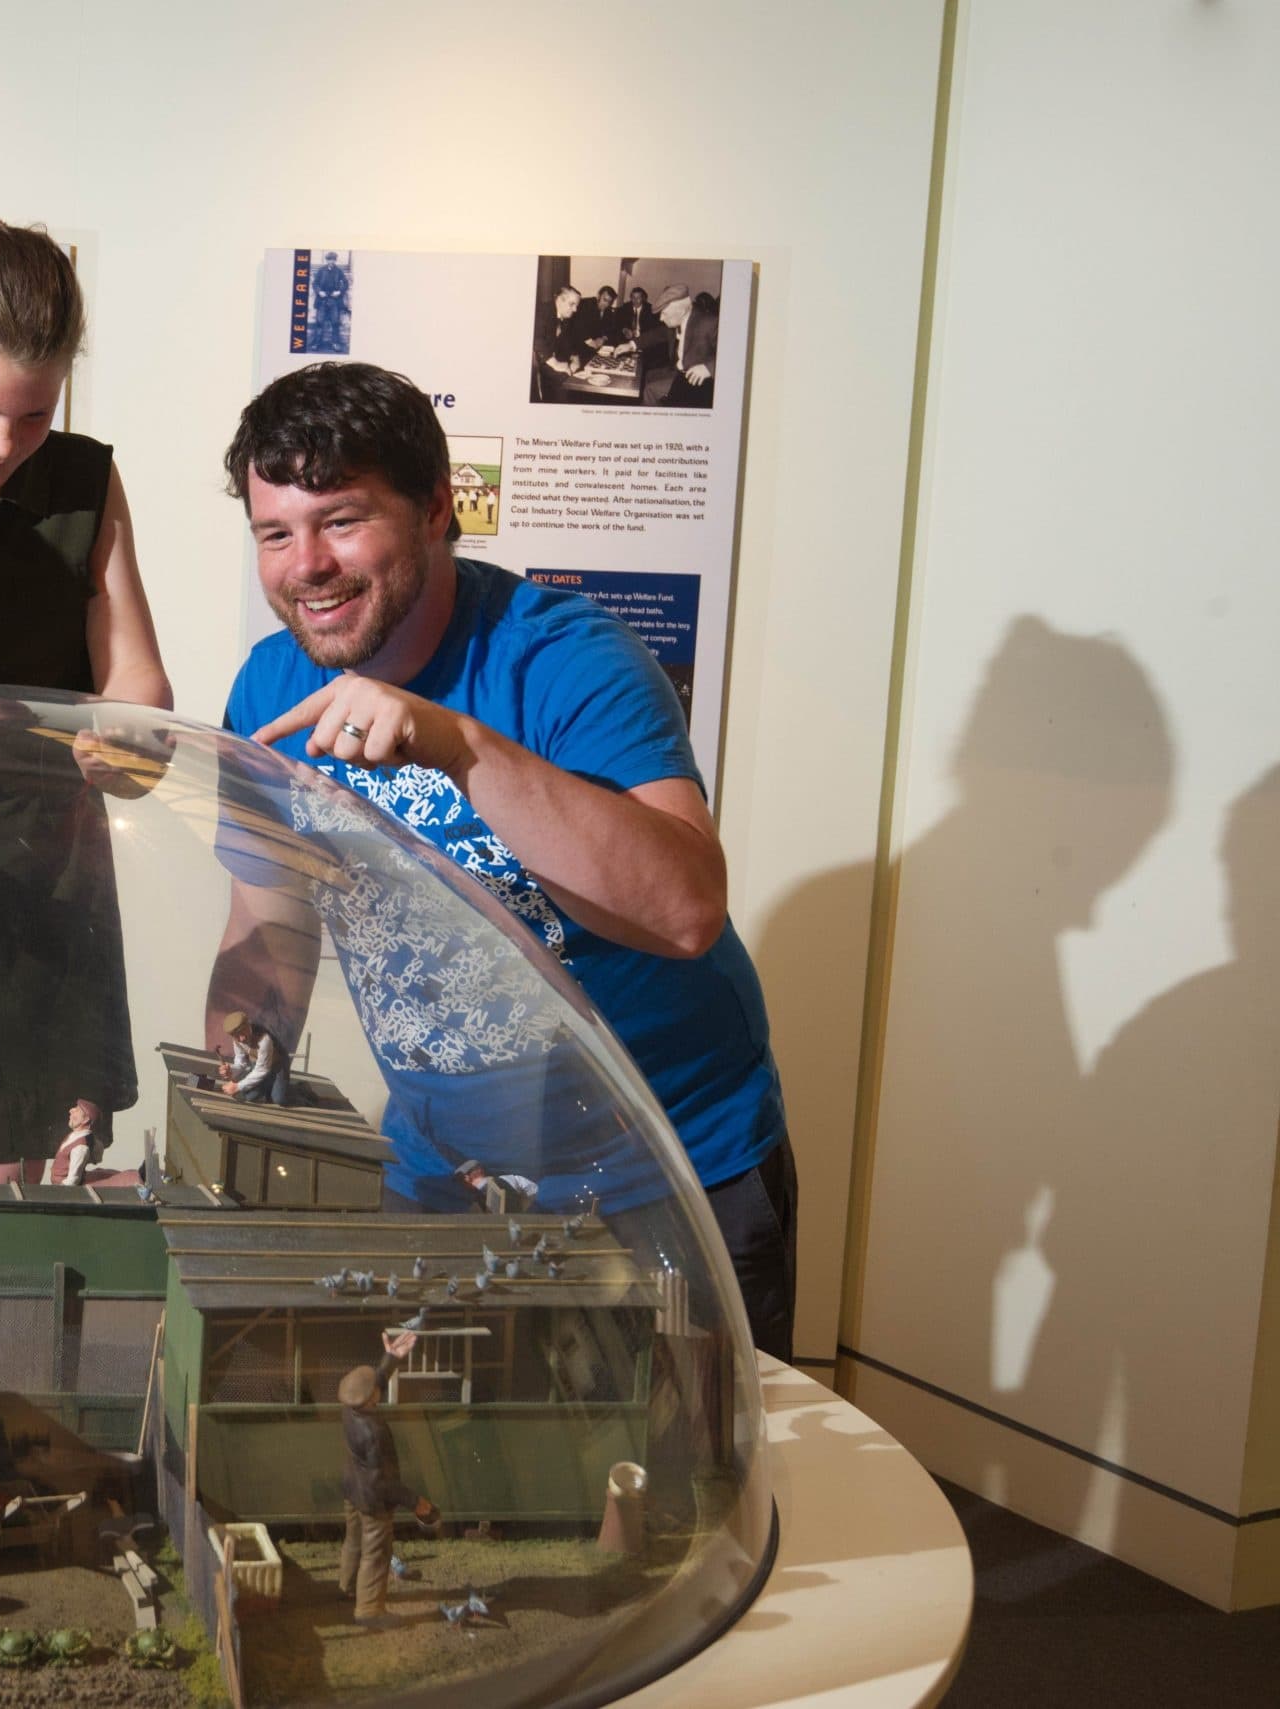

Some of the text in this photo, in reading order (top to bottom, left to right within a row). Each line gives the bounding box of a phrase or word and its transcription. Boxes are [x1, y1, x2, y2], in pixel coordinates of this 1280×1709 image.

[293, 255, 309, 349] WELFARE
[516, 437, 530, 446] The
[560, 439, 591, 448] Welfare
[592, 440, 612, 448] Fund
[643, 444, 653, 452] up
[686, 444, 703, 452] with
[514, 453, 536, 462] penny
[539, 453, 561, 461] levied
[613, 455, 622, 463] of
[657, 457, 708, 466] contributions
[512, 465, 532, 473] from
[602, 467, 609, 476] It
[614, 469, 632, 477] paid
[638, 469, 649, 477] for
[655, 470, 688, 478] facilities
[512, 480, 549, 488] institutes
[574, 482, 624, 490] convalescent
[664, 483, 684, 492] Each
[511, 493, 541, 501] decided
[562, 495, 579, 504] they
[612, 496, 632, 504] After
[693, 499, 706, 507] the
[510, 505, 529, 514] Coal
[531, 506, 562, 517] Industry
[566, 507, 588, 516] Social
[590, 508, 620, 517] Welfare
[623, 509, 673, 520] Organisation
[612, 523, 625, 531] the
[532, 574, 582, 584] KEY DATES
[598, 591, 608, 599] Act
[632, 592, 657, 601] Welfare
